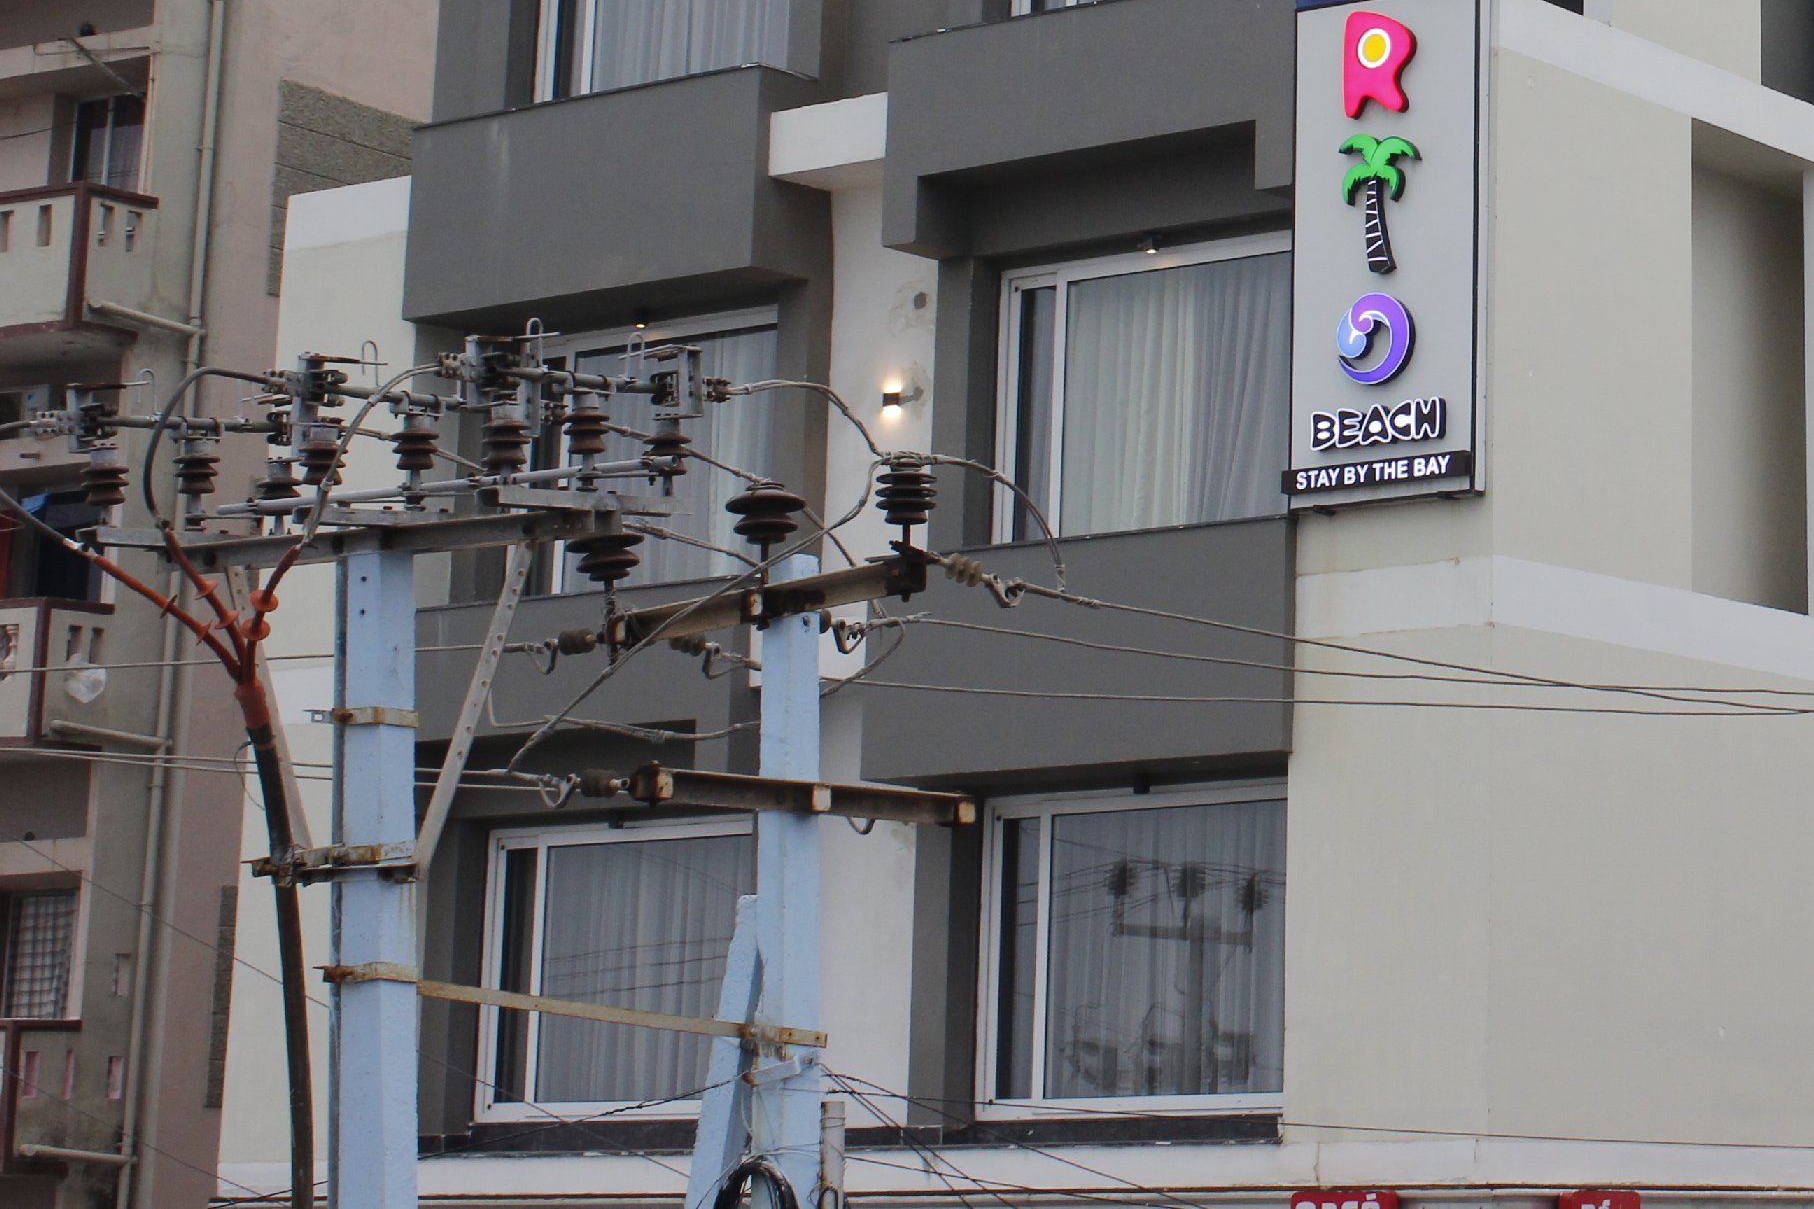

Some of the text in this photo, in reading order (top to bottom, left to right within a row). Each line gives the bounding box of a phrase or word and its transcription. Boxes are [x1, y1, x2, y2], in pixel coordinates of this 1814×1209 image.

[1310, 396, 1441, 451] BEACH
[1296, 454, 1450, 490] STAY BY THE BAY
